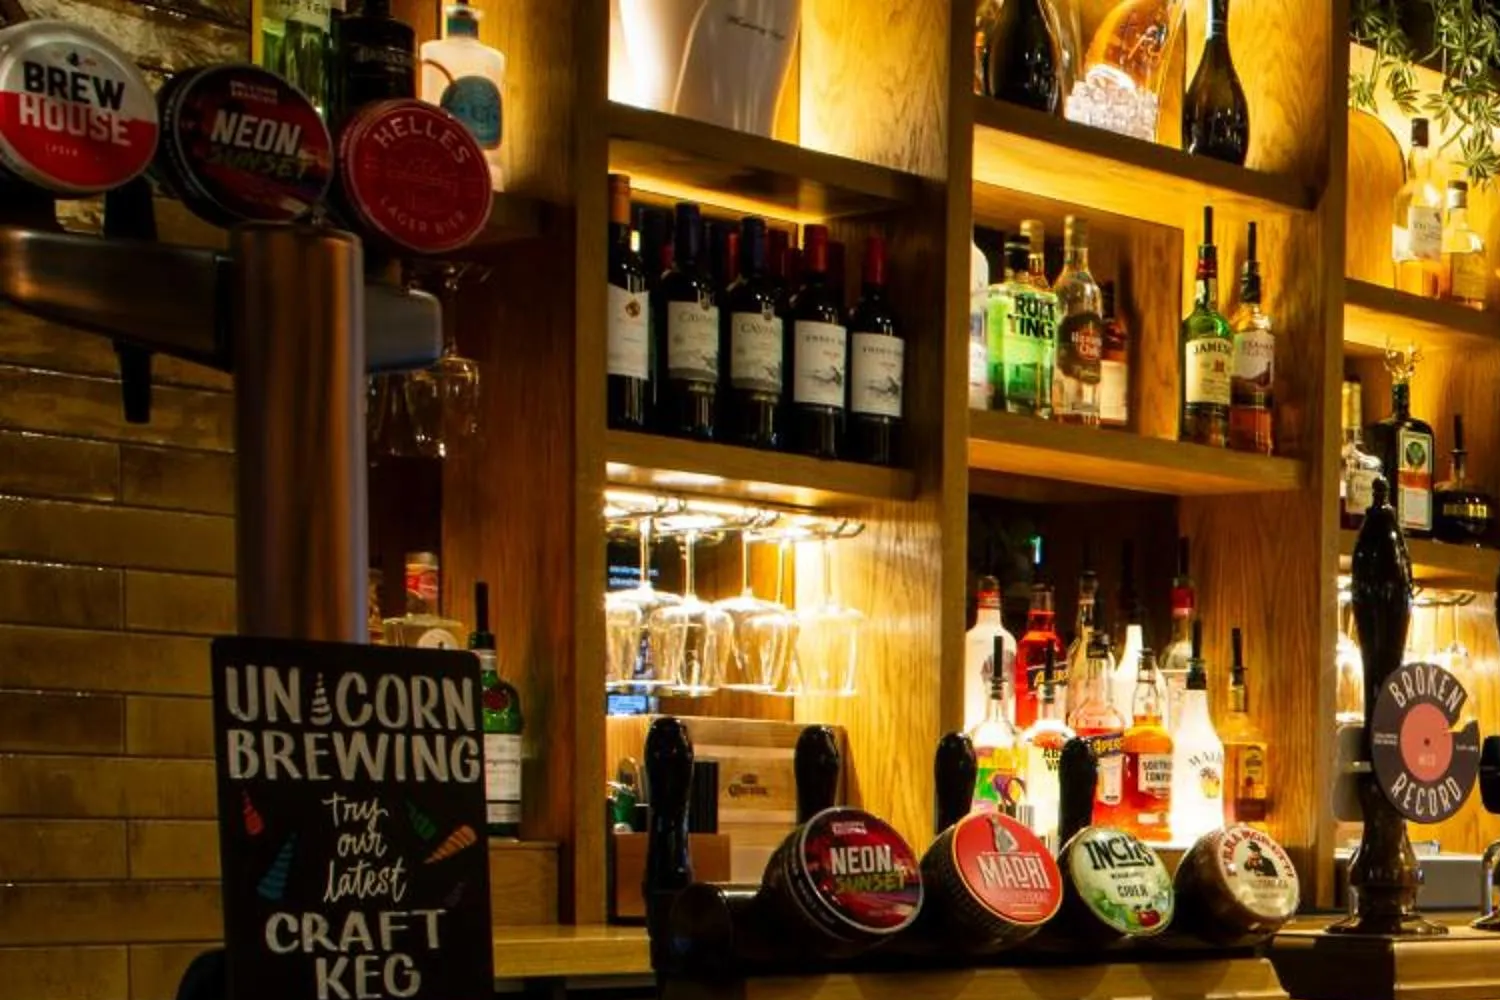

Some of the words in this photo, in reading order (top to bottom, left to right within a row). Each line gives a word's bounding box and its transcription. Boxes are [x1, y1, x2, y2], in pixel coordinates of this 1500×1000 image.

[23, 61, 125, 111] BREW
[19, 94, 132, 147] HOUSE
[210, 108, 302, 156] NEON
[372, 115, 472, 164] HELLES
[1388, 665, 1464, 713] BROKEN
[227, 729, 481, 784] BREWING
[1391, 772, 1463, 817] RECORD
[337, 831, 388, 858] our
[829, 845, 892, 875] NEON
[323, 856, 407, 903] latest
[265, 909, 448, 955] CRAFT
[315, 953, 422, 1000] KEG
